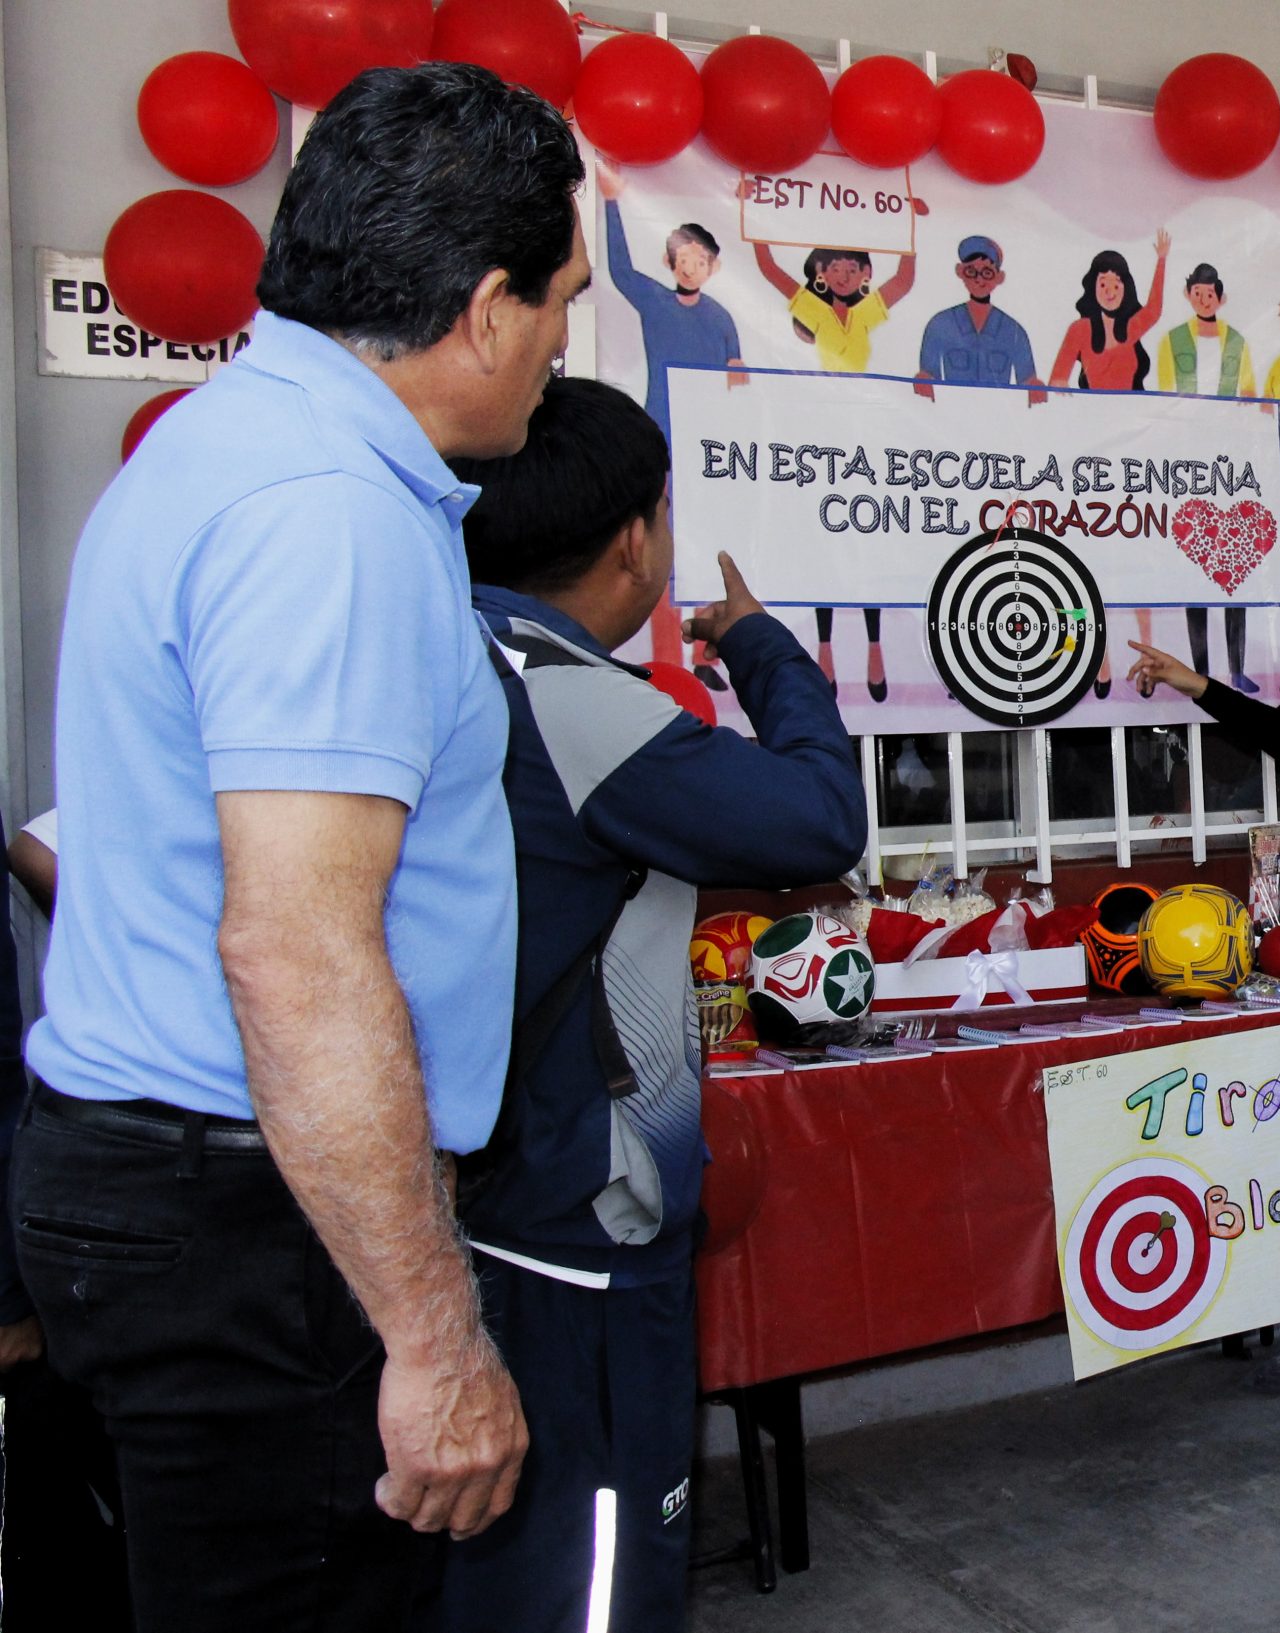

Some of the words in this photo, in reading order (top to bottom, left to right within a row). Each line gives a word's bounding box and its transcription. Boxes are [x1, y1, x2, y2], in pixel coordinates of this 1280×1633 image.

[753, 175, 813, 209] EST
[820, 182, 866, 211] No.
[875, 191, 903, 214] 60
[701, 439, 758, 481] EN
[768, 443, 877, 487] ESTA
[885, 447, 1063, 491] ESCUELA
[1071, 456, 1115, 495] SE
[1121, 455, 1261, 498] ENSEÑA
[819, 493, 910, 533] CON
[920, 496, 970, 535] EL
[979, 494, 1168, 538] CORAZÓN
[1013, 529, 1018, 538] 1
[1013, 551, 1019, 560] 3
[1014, 562, 1019, 570] 4
[1014, 572, 1020, 581] 5
[1015, 593, 1020, 601] 7
[1015, 603, 1021, 611] 8
[1015, 613, 1021, 622] 9
[931, 622, 935, 630] 1
[941, 622, 947, 631] 2
[951, 622, 957, 631] 3
[960, 622, 966, 630] 4
[970, 622, 976, 631] 5
[979, 622, 985, 631] 6
[989, 622, 995, 631] 7
[998, 622, 1004, 631] 8
[1008, 622, 1014, 631] 9
[1024, 623, 1030, 631] 9
[1033, 623, 1038, 631] 8
[1042, 622, 1048, 631] 7
[1051, 623, 1057, 631] 6
[1060, 623, 1066, 631] 5
[1070, 623, 1075, 631] 4
[1079, 623, 1084, 632] 3
[1088, 623, 1093, 631] 2
[1098, 623, 1102, 632] 1
[1016, 631, 1022, 640] 9
[1016, 642, 1022, 650] 8
[1016, 652, 1022, 660] 7
[1017, 673, 1023, 681] 5
[1017, 693, 1023, 702] 3
[1018, 704, 1023, 712] 2
[1019, 716, 1023, 724] 1
[1097, 1064, 1108, 1078] 60
[662, 1477, 689, 1516] GTO
